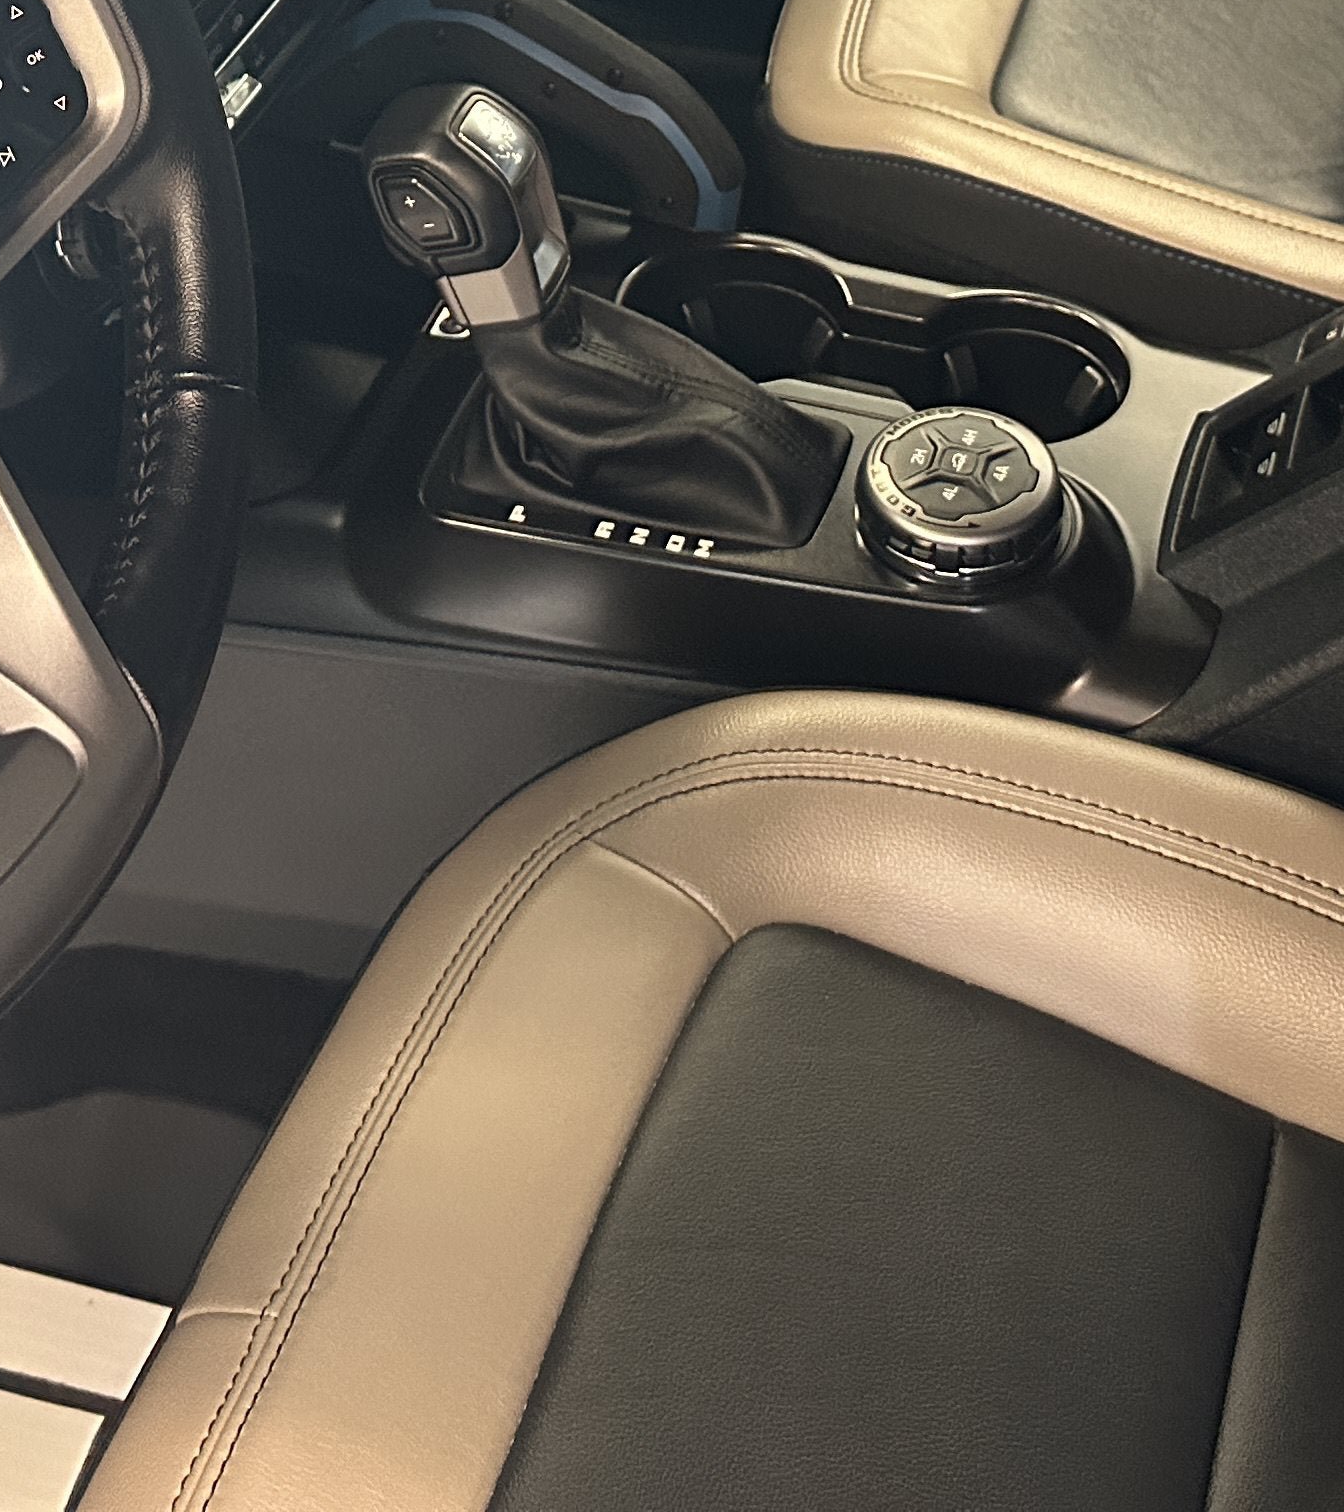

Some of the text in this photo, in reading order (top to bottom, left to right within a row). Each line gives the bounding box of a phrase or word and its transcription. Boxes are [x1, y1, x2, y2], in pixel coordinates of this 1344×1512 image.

[27, 49, 45, 65] OK
[962, 429, 978, 445] 4H
[911, 448, 927, 465] 2H
[993, 465, 1010, 482] 4A
[942, 486, 959, 501] 4L
[508, 504, 526, 523] P
[629, 527, 650, 546] N
[665, 534, 686, 553] D
